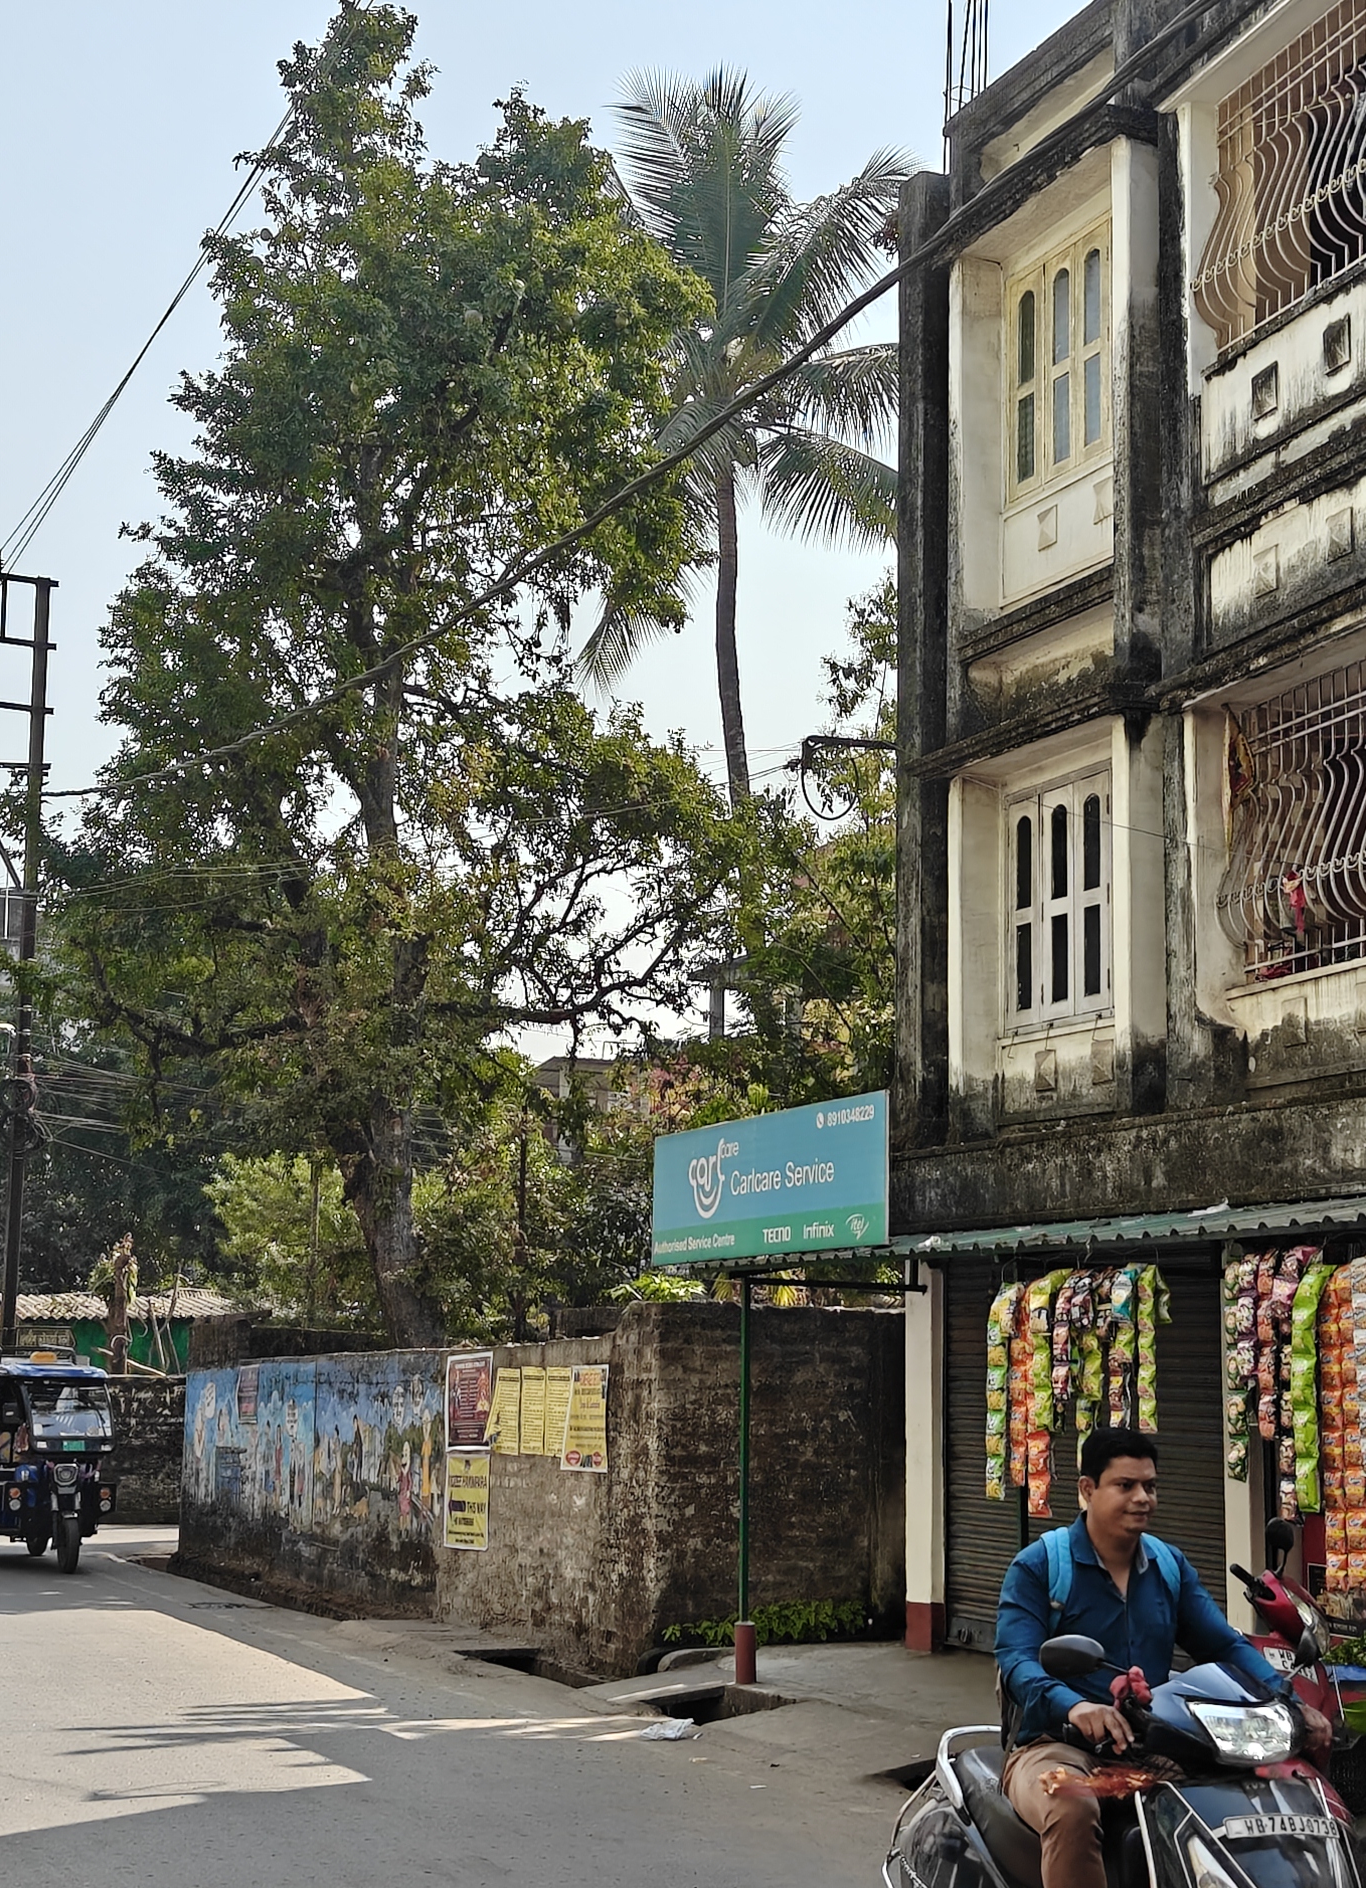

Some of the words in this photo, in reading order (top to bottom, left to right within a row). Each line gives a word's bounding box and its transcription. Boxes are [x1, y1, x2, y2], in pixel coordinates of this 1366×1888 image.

[730, 1167, 782, 1196] Carlcare
[785, 1157, 835, 1188] Service
[762, 1226, 791, 1244] TECNO
[803, 1221, 835, 1240] Infinix
[654, 1236, 688, 1254] Authorised
[688, 1234, 712, 1251] Service
[712, 1232, 736, 1249] Centre
